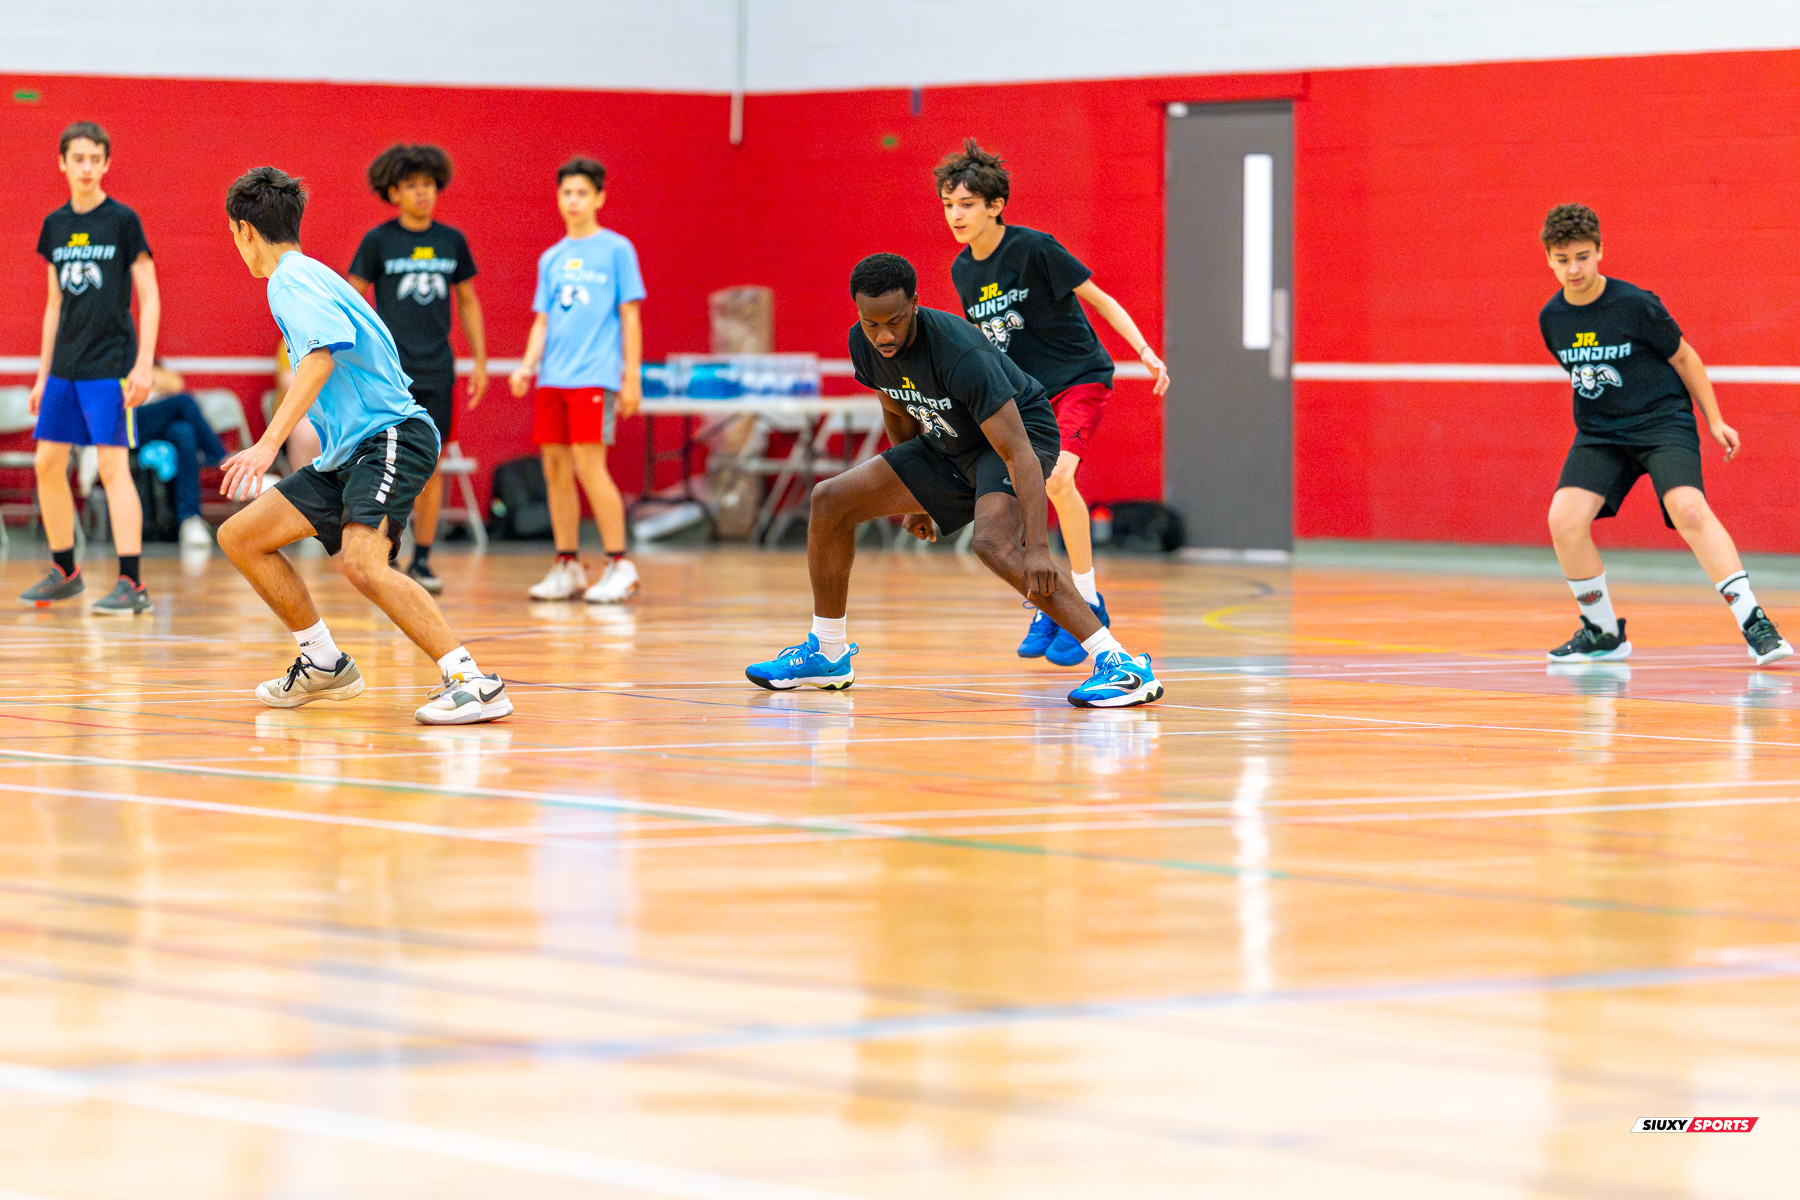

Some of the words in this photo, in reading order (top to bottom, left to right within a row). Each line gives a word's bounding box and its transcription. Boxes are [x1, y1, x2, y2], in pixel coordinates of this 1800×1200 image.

[52, 245, 116, 263] OUNDRA
[979, 282, 1003, 303] JR.
[967, 288, 1029, 320] OUNDRA
[1572, 332, 1599, 348] JR.
[1557, 342, 1632, 364] OUNDRA
